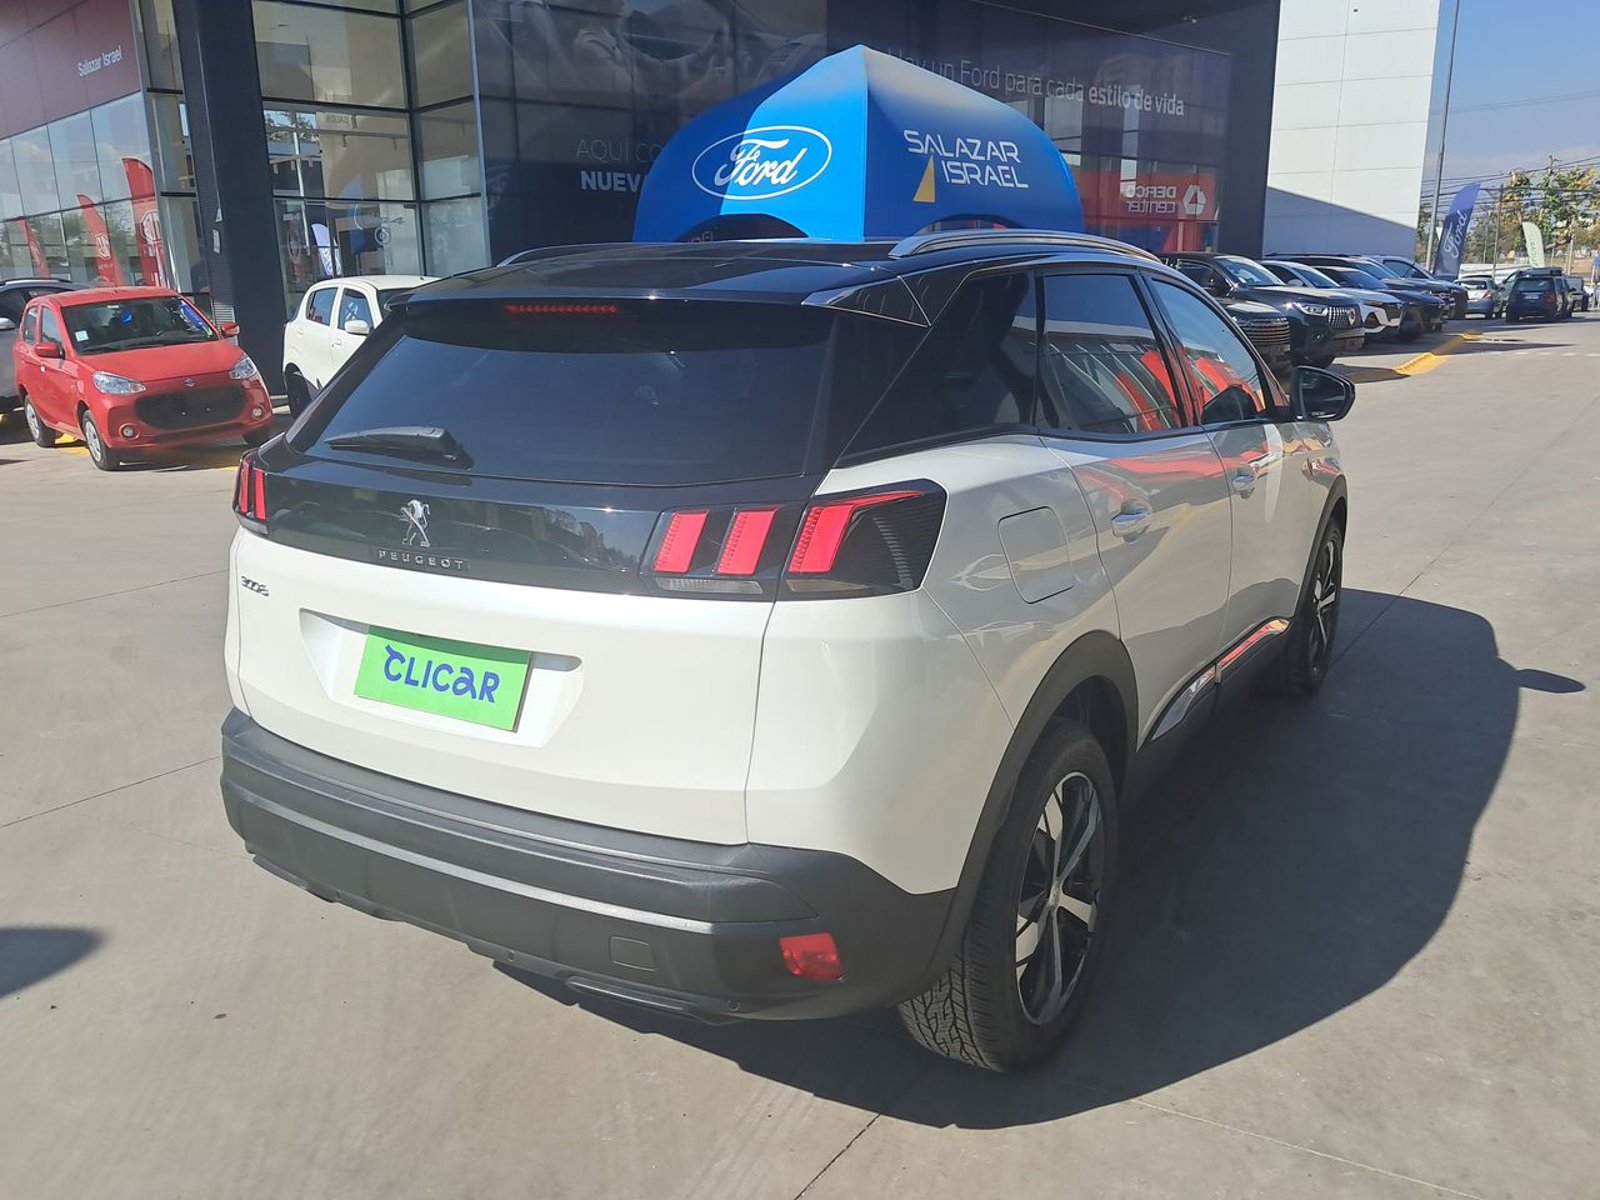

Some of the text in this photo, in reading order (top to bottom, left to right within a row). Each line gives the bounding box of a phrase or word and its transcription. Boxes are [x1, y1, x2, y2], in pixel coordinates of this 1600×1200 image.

[101, 44, 123, 66] Israel
[960, 60, 1000, 89] Ford
[1004, 73, 1042, 96] para
[1046, 77, 1084, 101] cada
[1088, 84, 1131, 109] estilo
[1133, 88, 1152, 111] de
[1155, 92, 1184, 116] vida
[714, 138, 808, 186] Ford
[903, 129, 1021, 163] SALAZAR
[580, 170, 641, 193] NUEV
[941, 159, 1029, 189] ISRAEL
[1443, 209, 1467, 259] Ford
[377, 549, 465, 570] PEUGEOT
